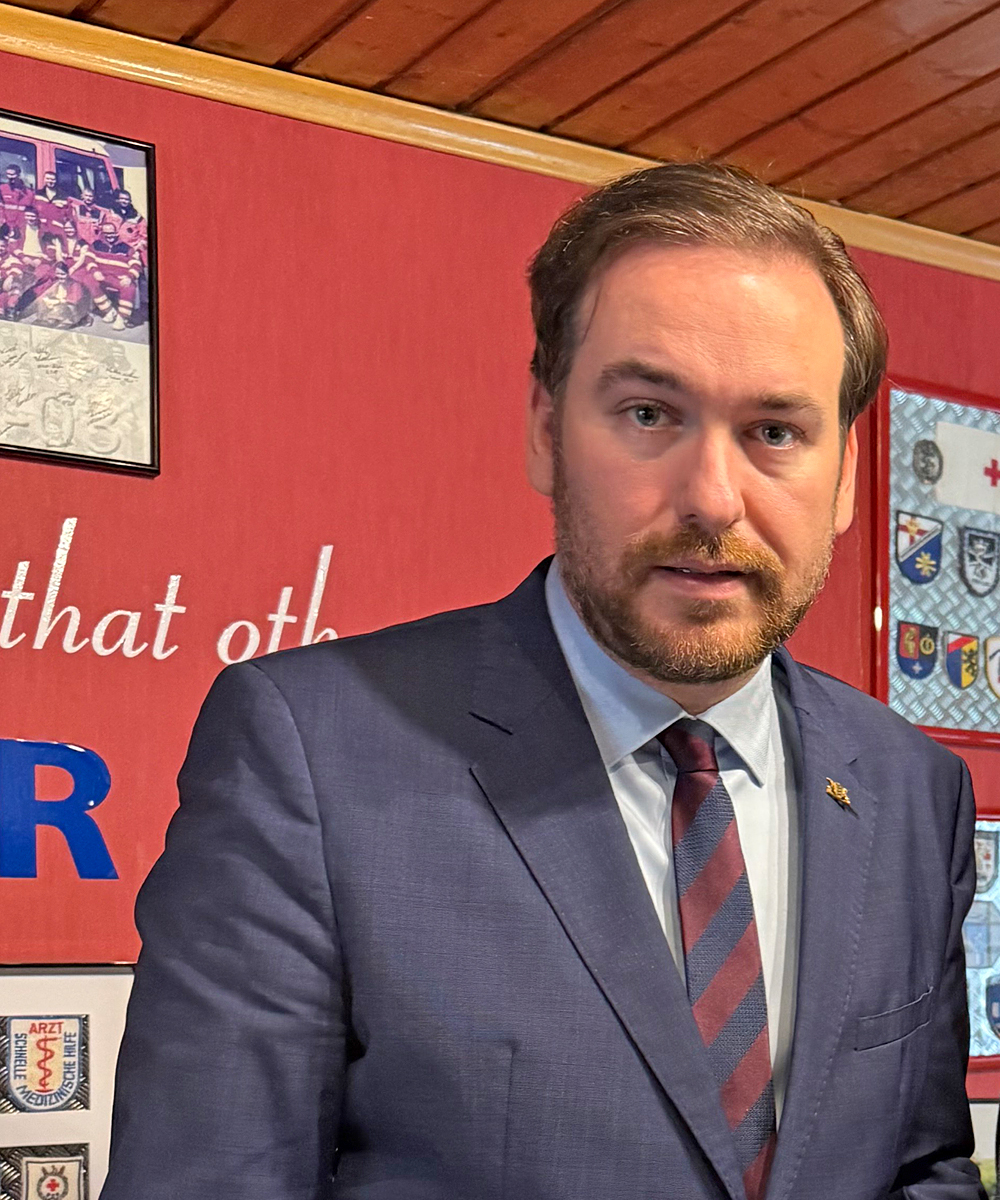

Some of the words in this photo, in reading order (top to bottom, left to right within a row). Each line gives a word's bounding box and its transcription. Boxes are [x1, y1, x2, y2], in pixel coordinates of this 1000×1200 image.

[0, 517, 187, 660] that
[0, 738, 120, 880] R
[14, 1032, 28, 1080] SCHNELLE
[63, 1031, 77, 1058] HILFE
[29, 1021, 64, 1034] ARZT
